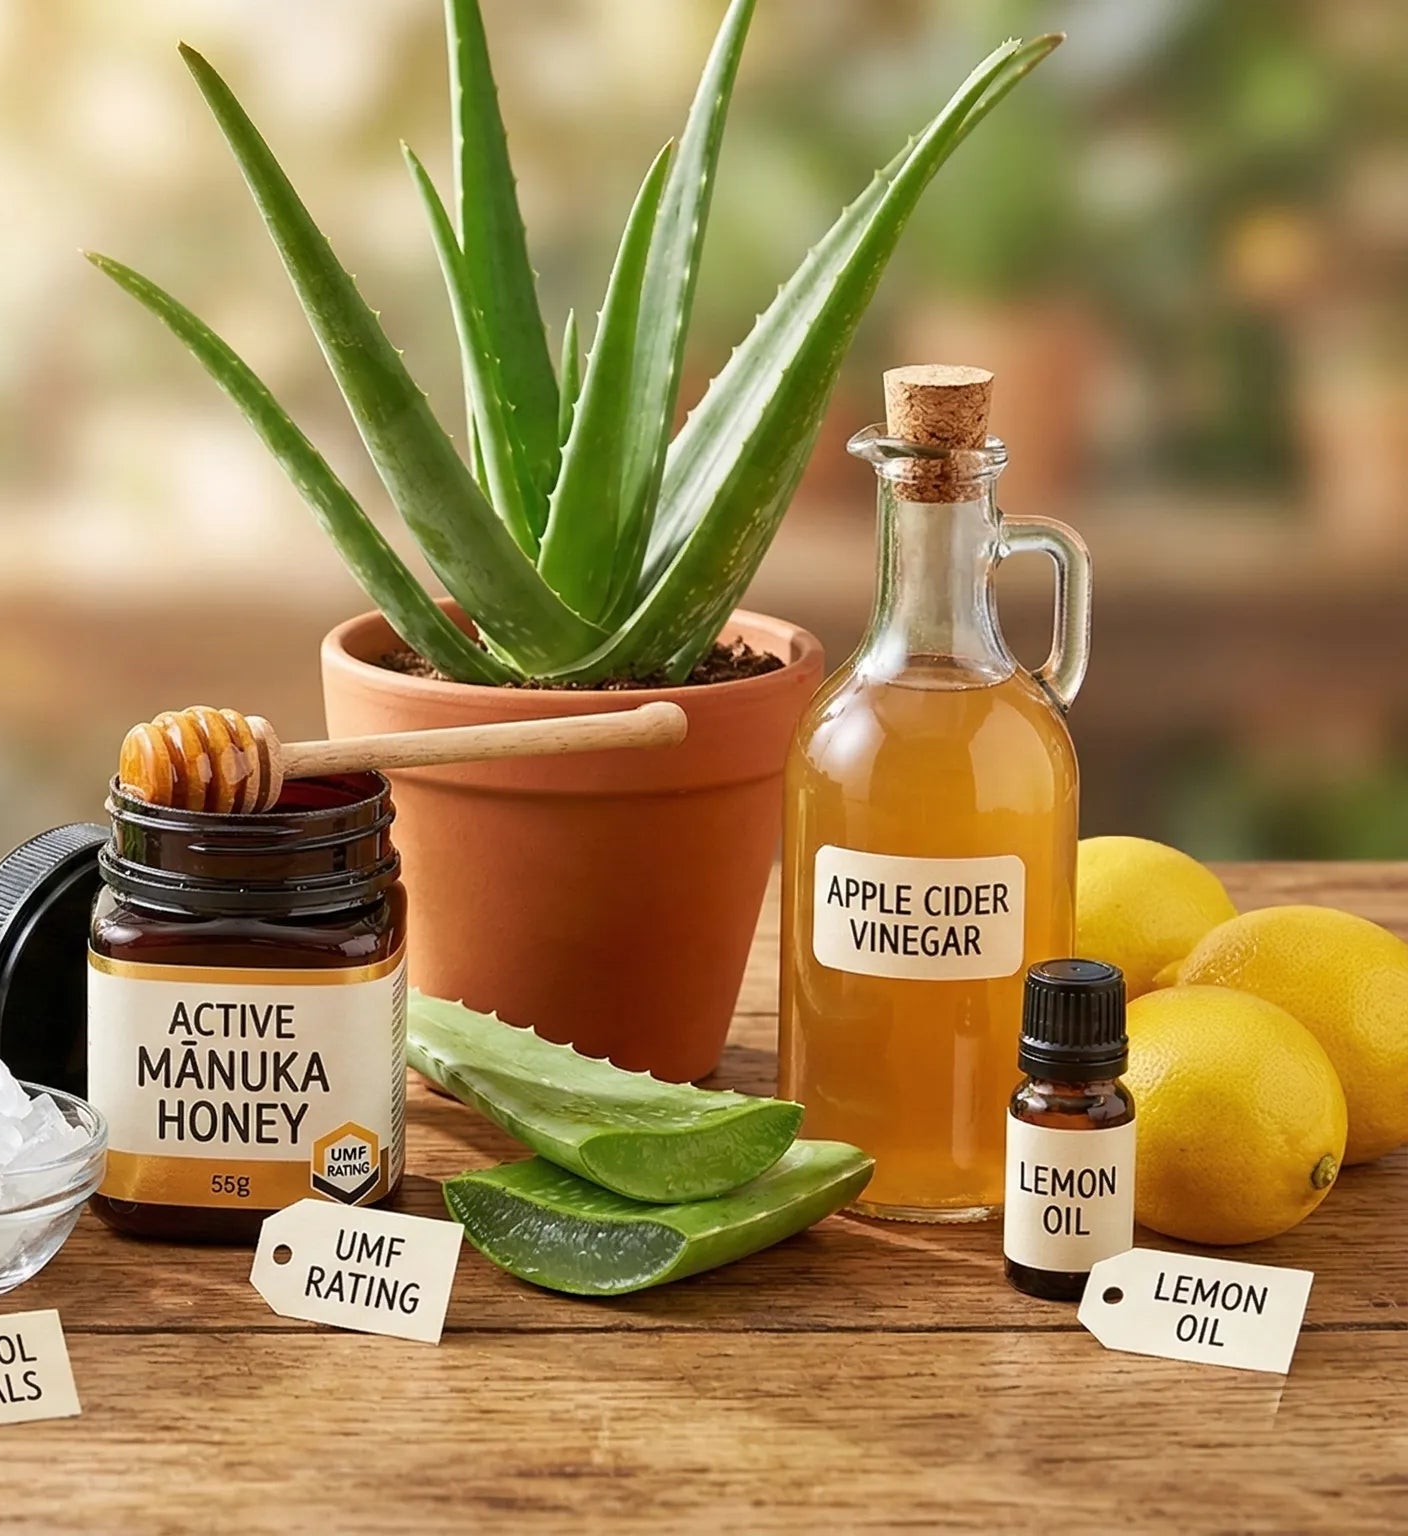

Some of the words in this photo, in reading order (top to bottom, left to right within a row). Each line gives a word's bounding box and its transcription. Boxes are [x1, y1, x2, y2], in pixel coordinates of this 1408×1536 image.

[827, 875, 912, 916] APPLE
[923, 883, 1009, 917] CIDER
[849, 918, 982, 957] VINEGAR
[168, 1001, 296, 1039] ACTIVE
[138, 1040, 330, 1093] MĀNUKA
[158, 1098, 309, 1145] HONEY
[327, 1161, 370, 1177] RATING
[330, 1145, 367, 1162] UMF
[211, 1174, 251, 1198] 55g
[1020, 1161, 1116, 1199] LEMON
[1043, 1205, 1091, 1236] OIL
[335, 1229, 406, 1268] UMF
[304, 1265, 420, 1315] RATING
[1154, 1272, 1268, 1315] LEMON
[1176, 1314, 1224, 1347] OIL
